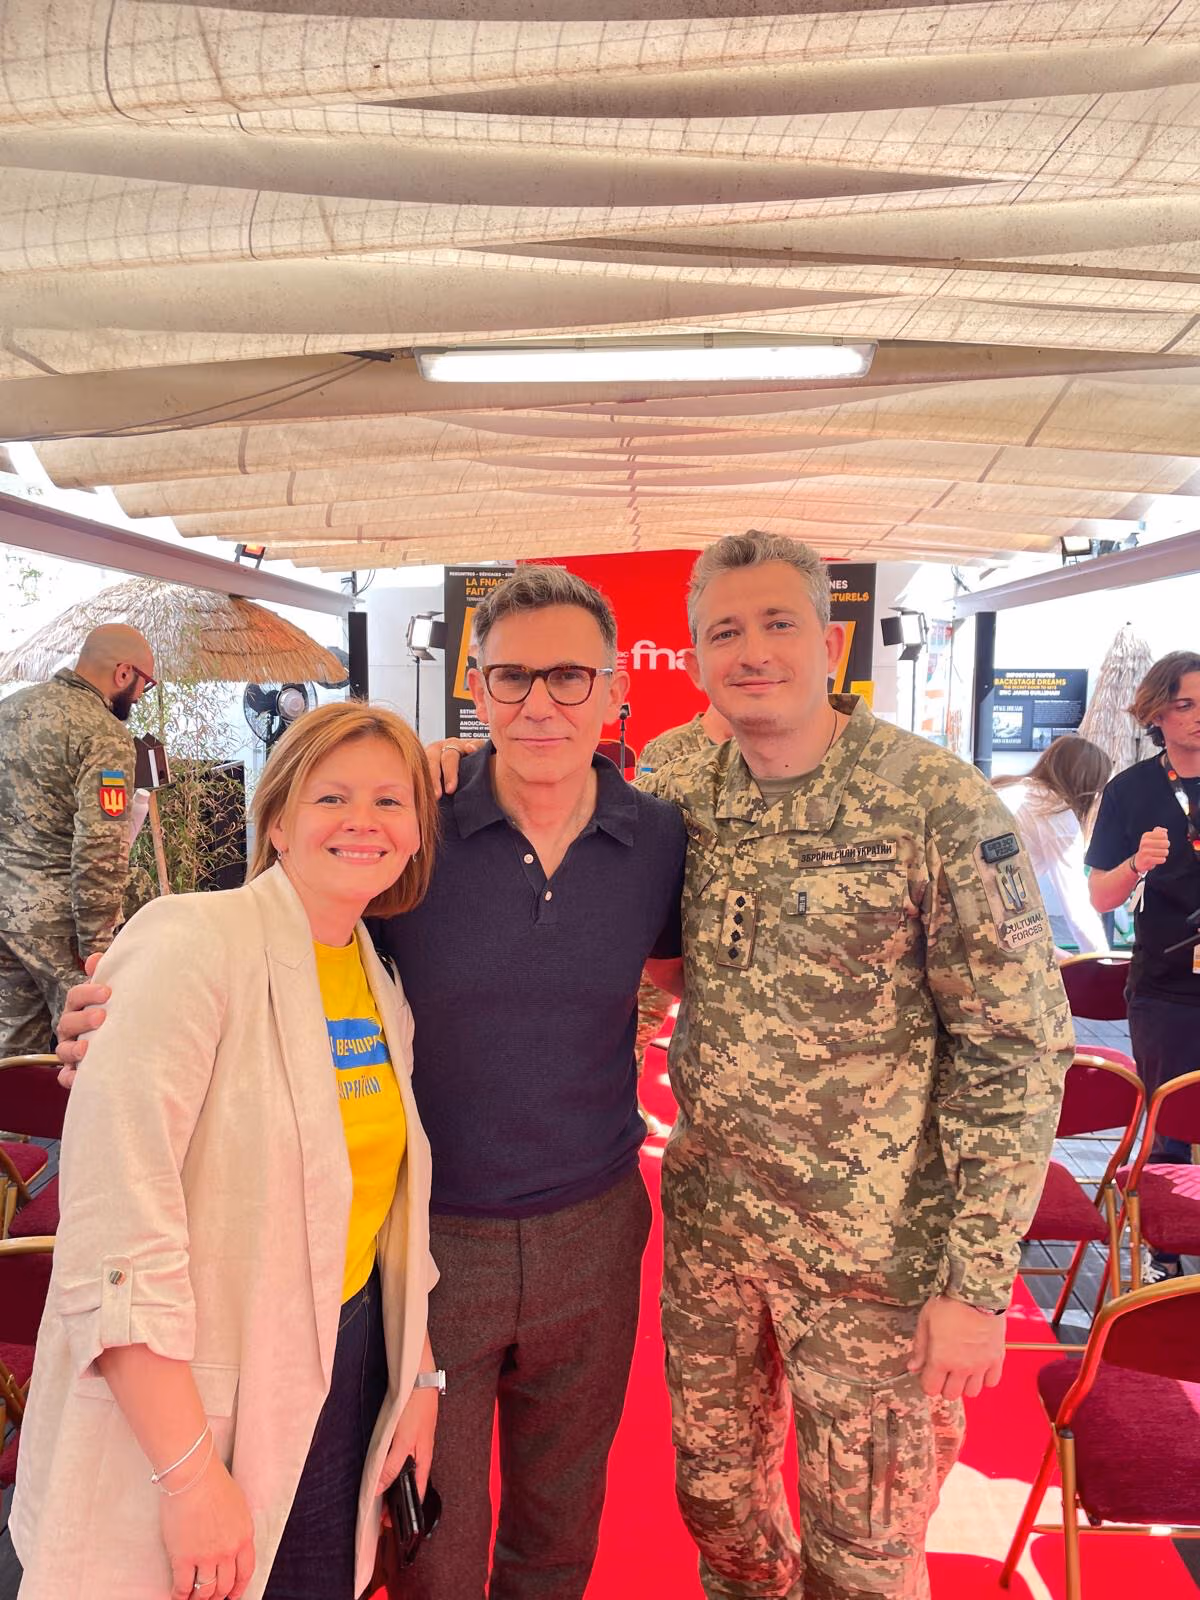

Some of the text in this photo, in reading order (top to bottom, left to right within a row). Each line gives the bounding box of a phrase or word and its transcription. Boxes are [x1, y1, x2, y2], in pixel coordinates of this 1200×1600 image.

[466, 578, 478, 586] LA
[857, 844, 892, 857] УКРАЇНИ
[1005, 913, 1044, 935] CULTURAL
[1011, 923, 1043, 943] FORCES
